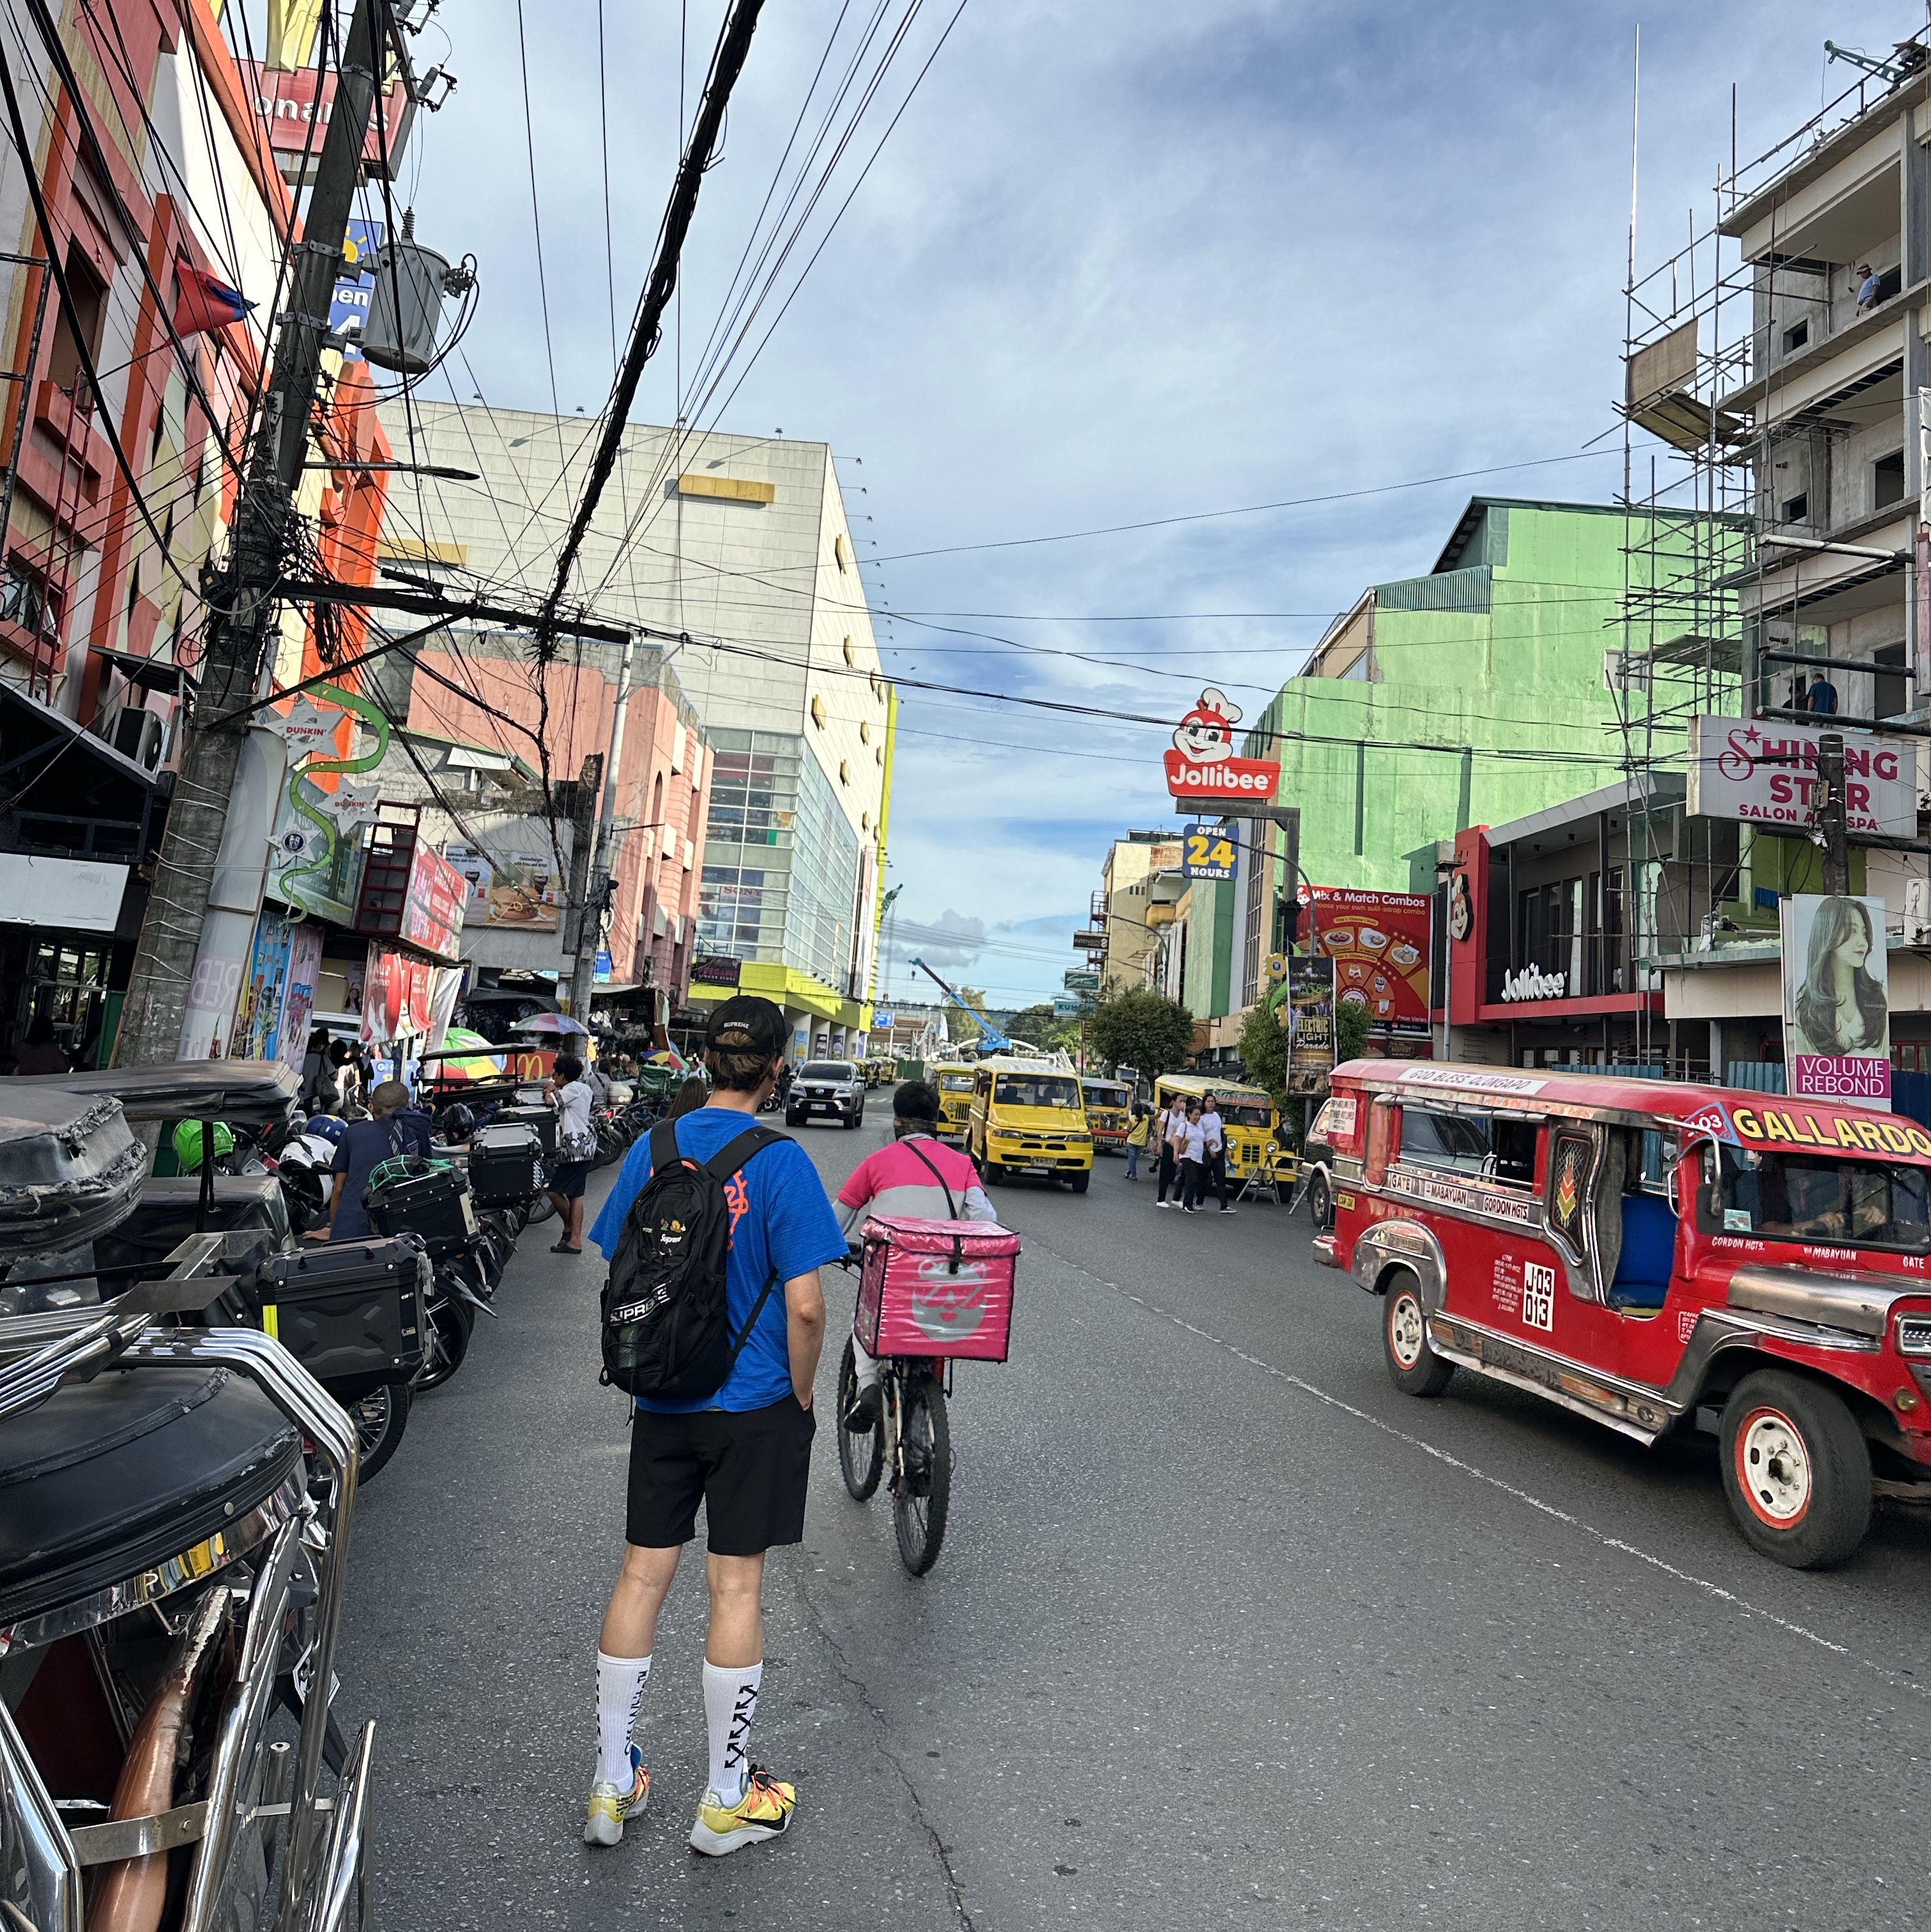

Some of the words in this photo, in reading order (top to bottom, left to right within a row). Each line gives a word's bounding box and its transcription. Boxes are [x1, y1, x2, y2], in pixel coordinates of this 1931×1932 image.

[1170, 763, 1269, 790] Jollibee
[1770, 774, 1870, 813] STR
[1739, 803, 1797, 822] SALON
[1847, 816, 1879, 832] SPA
[1196, 826, 1226, 837] OPEN
[1187, 835, 1236, 869] 24
[1190, 867, 1230, 879] HOURS
[1333, 892, 1341, 901] &
[1344, 892, 1378, 904] Match
[1382, 894, 1426, 908] Combos
[1336, 903, 1350, 911] your
[1367, 905, 1401, 915] sulit-sarap
[1500, 962, 1568, 1003] Jollibee
[1298, 1018, 1328, 1033] ELECTRIC
[1295, 1039, 1330, 1049] Parade
[1297, 1032, 1329, 1041] LIGHT
[1801, 1057, 1884, 1078] VOLUME
[1409, 1070, 1433, 1080] GOD
[1433, 1072, 1470, 1084] BLESS
[1469, 1076, 1532, 1091] OLONGAPO
[1801, 1074, 1884, 1096] REBOND
[1732, 1107, 1931, 1158] GALLARDO
[1391, 1174, 1410, 1192] GATE
[1431, 1183, 1467, 1205] MABAYUAN
[1483, 1196, 1511, 1215] GORDON
[1711, 1236, 1744, 1249] GORDON
[1812, 1247, 1858, 1261] MABAYUAN
[1902, 1256, 1925, 1270] GATE
[1525, 1293, 1549, 1327] 013
